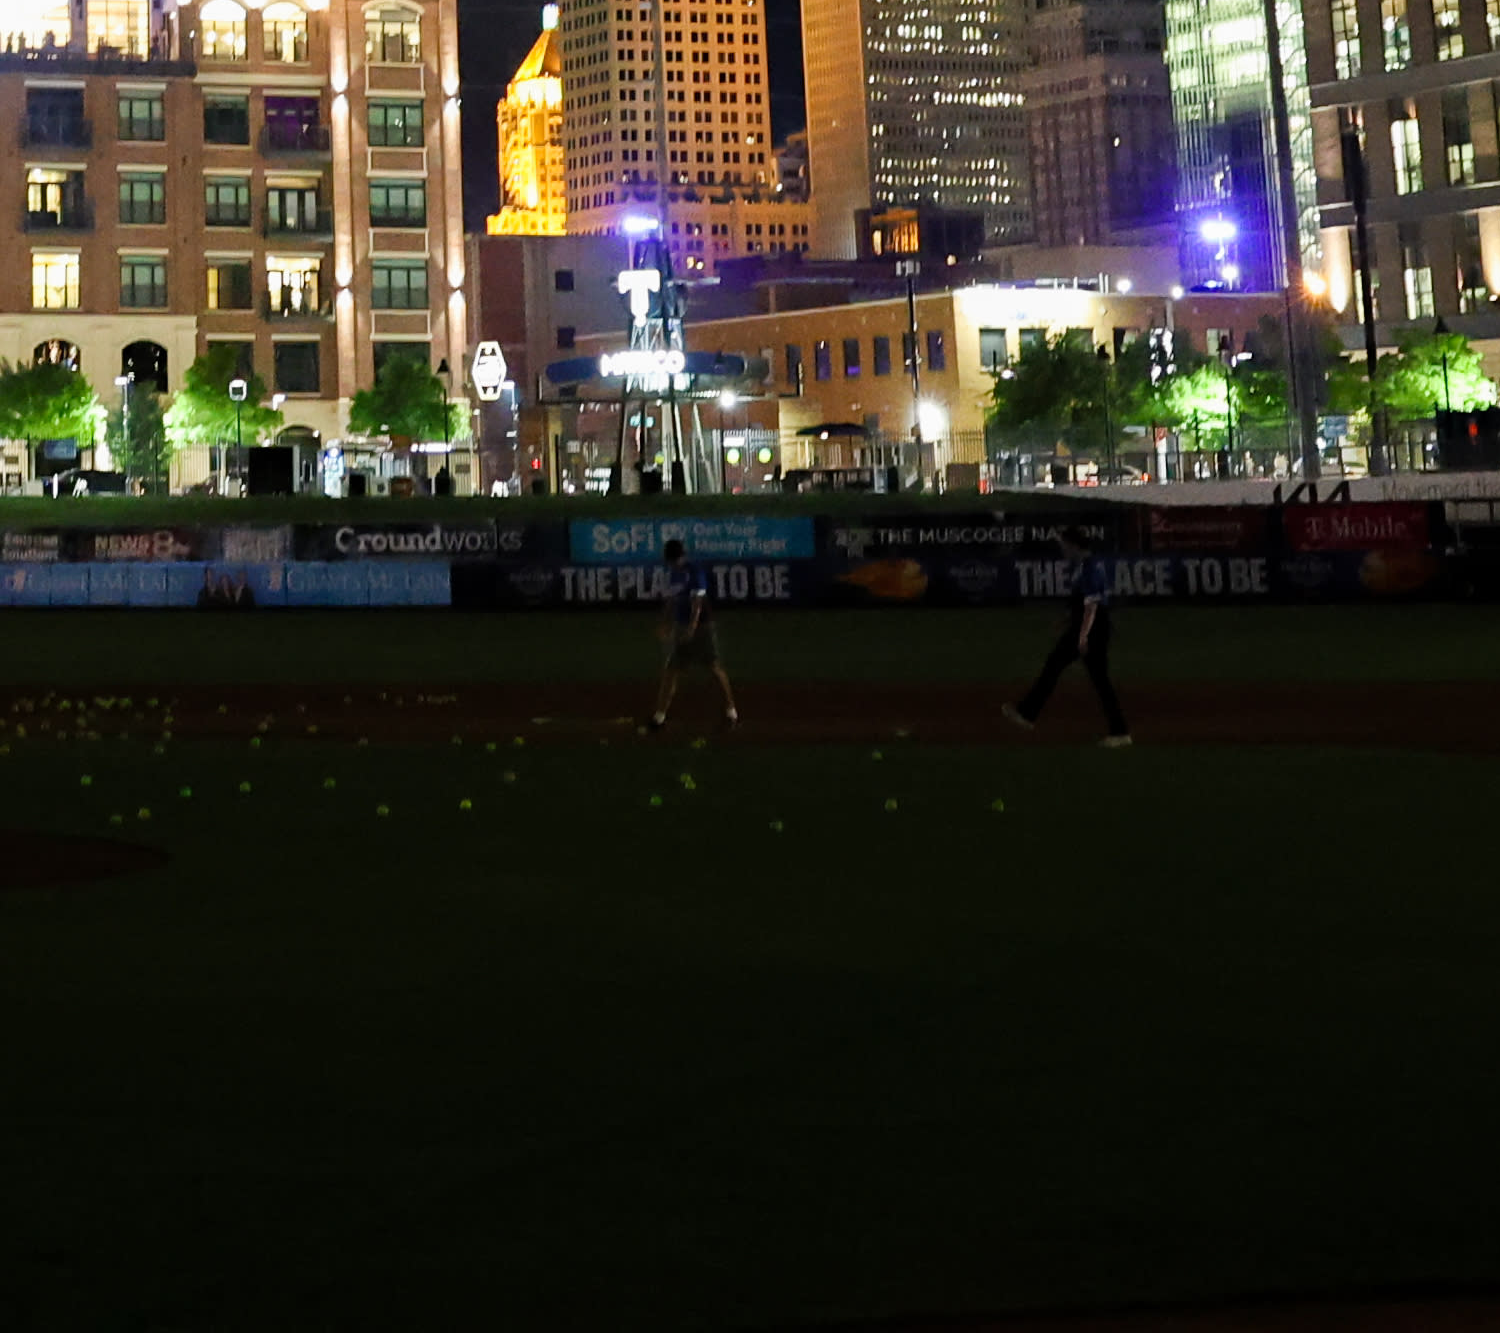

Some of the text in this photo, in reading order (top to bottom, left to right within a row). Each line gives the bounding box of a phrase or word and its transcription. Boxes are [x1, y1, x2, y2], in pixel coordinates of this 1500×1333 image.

[592, 523, 655, 553] SoFi
[879, 524, 1105, 545] THE MUSCOGEE NAON
[560, 565, 791, 601] THE PLA TO BE
[1014, 556, 1270, 597] THE ACE TO BE
